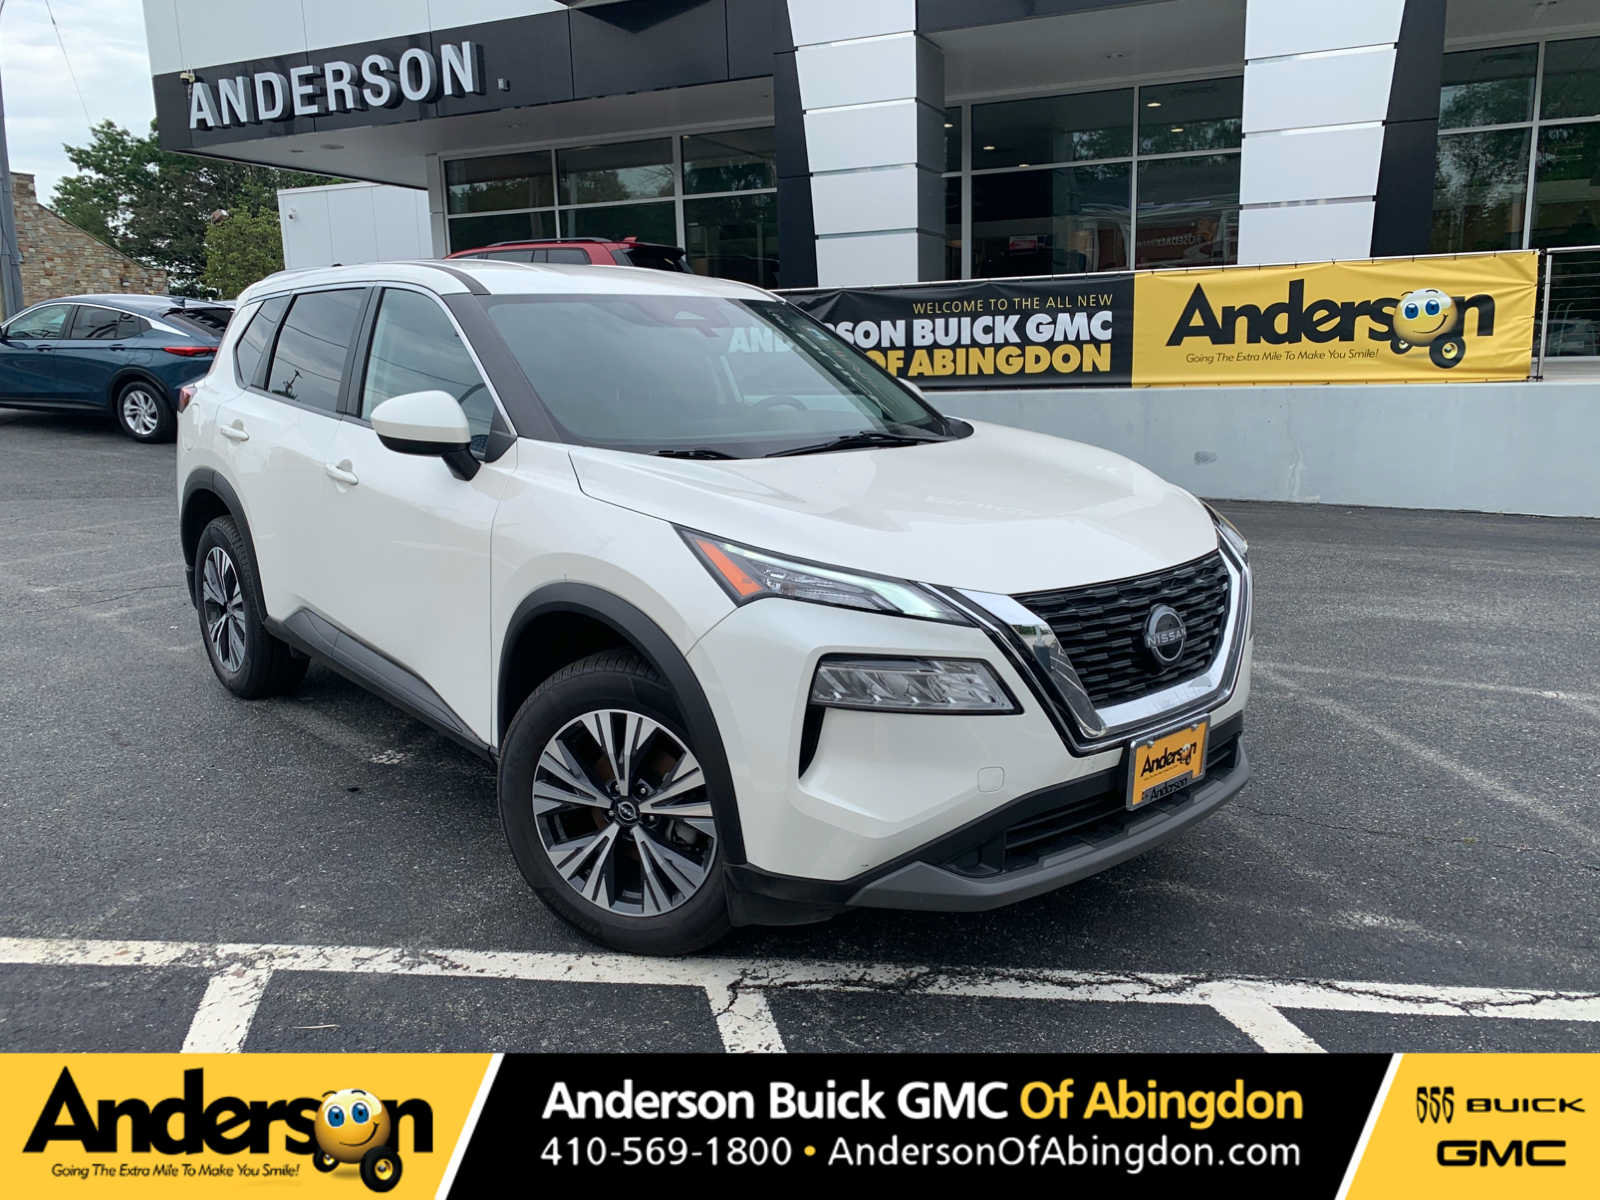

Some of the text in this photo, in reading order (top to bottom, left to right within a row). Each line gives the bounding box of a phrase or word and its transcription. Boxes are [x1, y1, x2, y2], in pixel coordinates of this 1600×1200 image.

[189, 41, 476, 130] ANDERSON
[913, 294, 1113, 314] WELCOME TO THE ALL NEW
[913, 314, 1021, 347] BUICK
[1025, 310, 1113, 343] GMC
[907, 343, 1111, 377] ABINGDON
[1186, 348, 1380, 364] Going The Extra Mile To Make You Smile!
